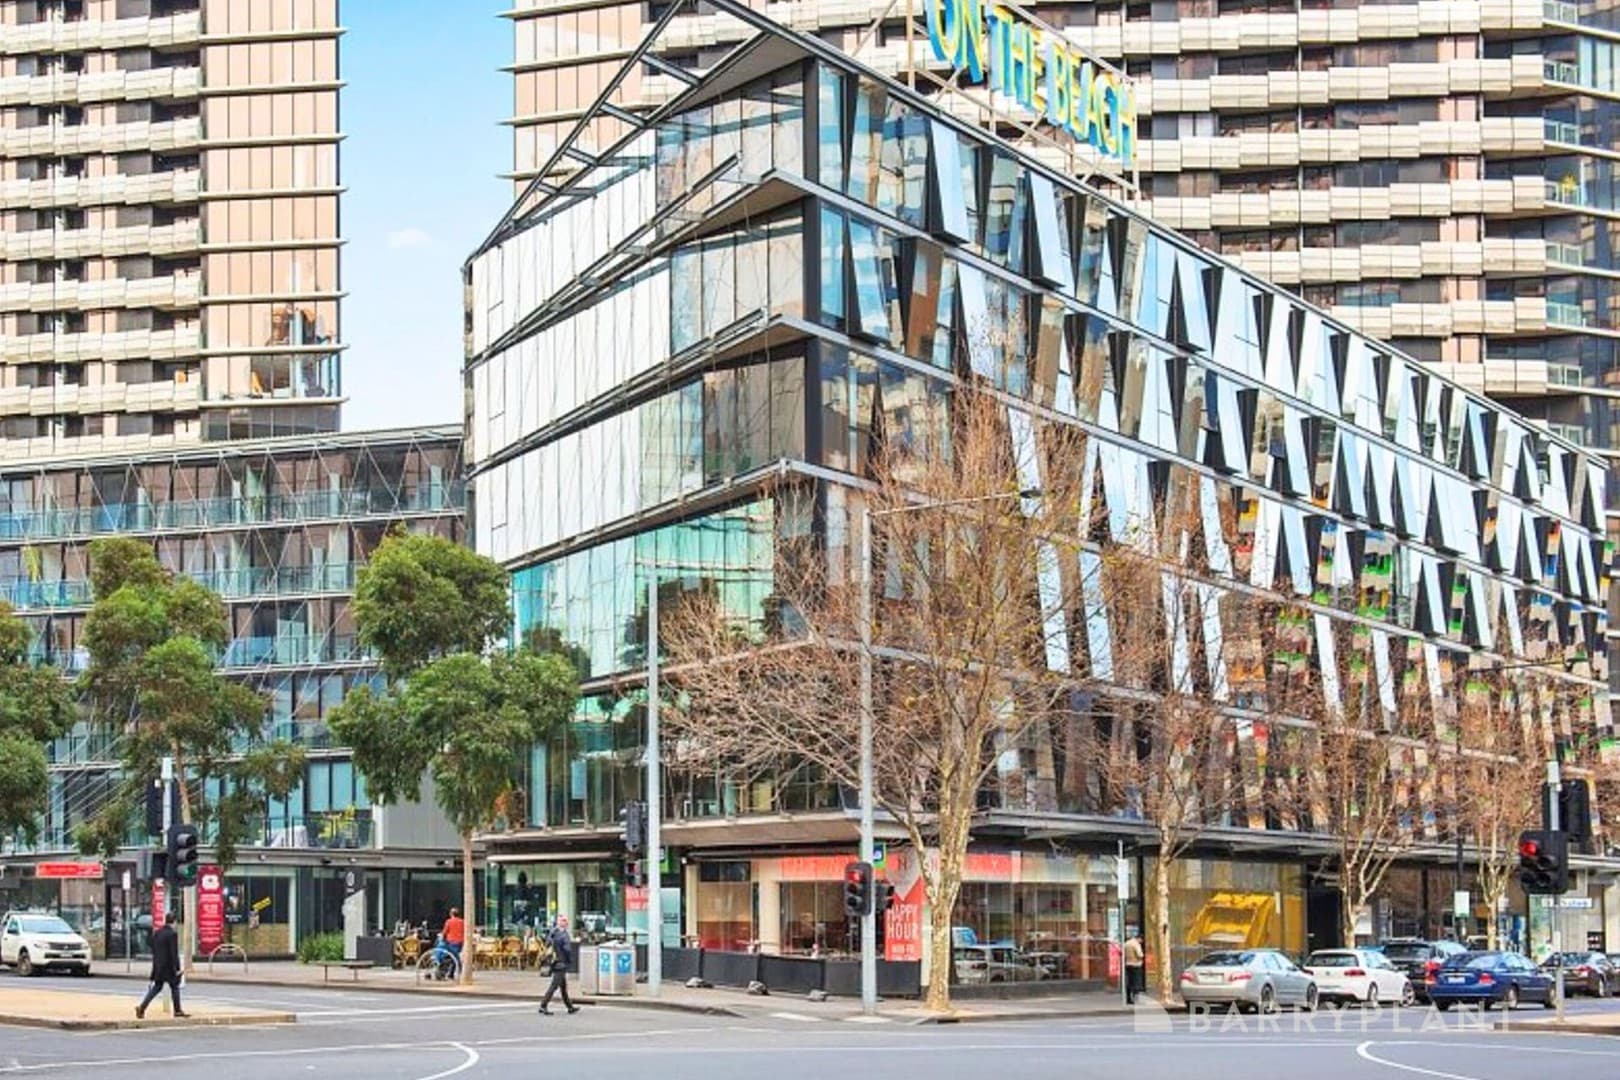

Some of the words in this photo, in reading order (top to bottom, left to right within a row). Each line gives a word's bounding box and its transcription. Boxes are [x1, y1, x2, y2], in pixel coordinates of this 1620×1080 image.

[924, 0, 986, 83] ON
[984, 2, 1047, 114] THE
[1045, 38, 1137, 170] BEACH
[887, 921, 919, 940] HOUR
